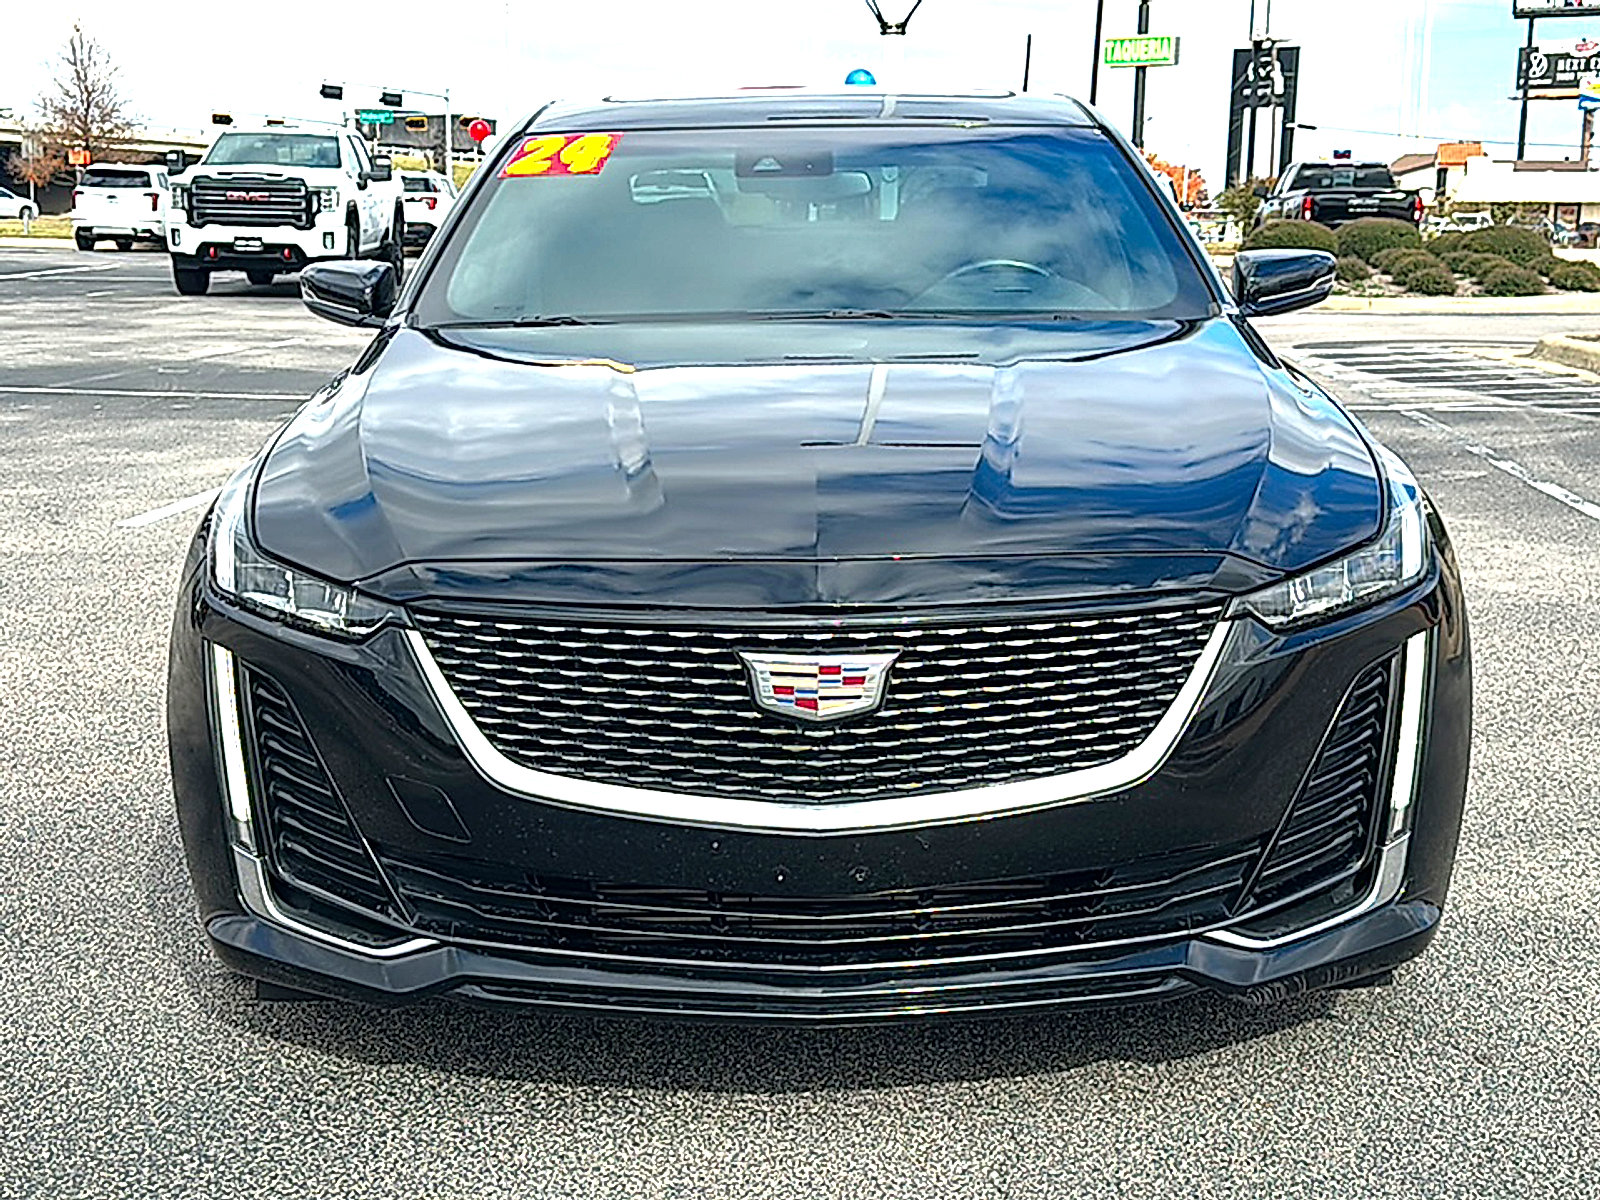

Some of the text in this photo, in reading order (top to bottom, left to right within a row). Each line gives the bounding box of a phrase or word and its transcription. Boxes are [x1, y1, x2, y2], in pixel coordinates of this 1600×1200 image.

[1105, 39, 1171, 61] TAQUERIA
[505, 134, 613, 174] 24
[226, 190, 270, 201] GMC
